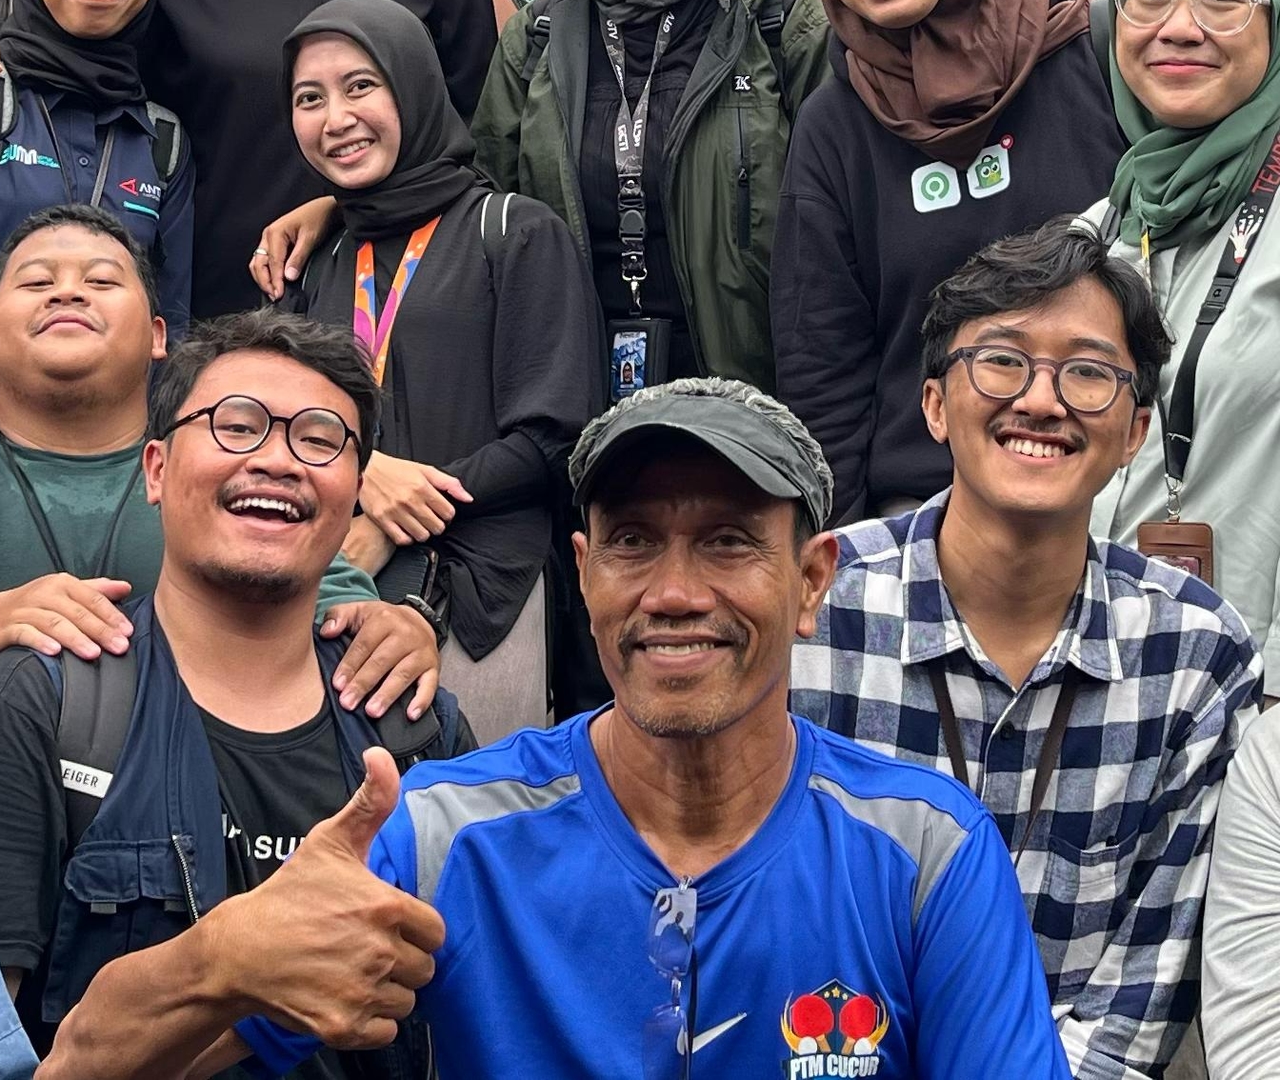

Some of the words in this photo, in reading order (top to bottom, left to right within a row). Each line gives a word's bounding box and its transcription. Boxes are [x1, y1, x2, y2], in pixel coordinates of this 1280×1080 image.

[606, 19, 619, 40] GTV
[62, 768, 99, 788] EIGER
[790, 1054, 824, 1080] PTM
